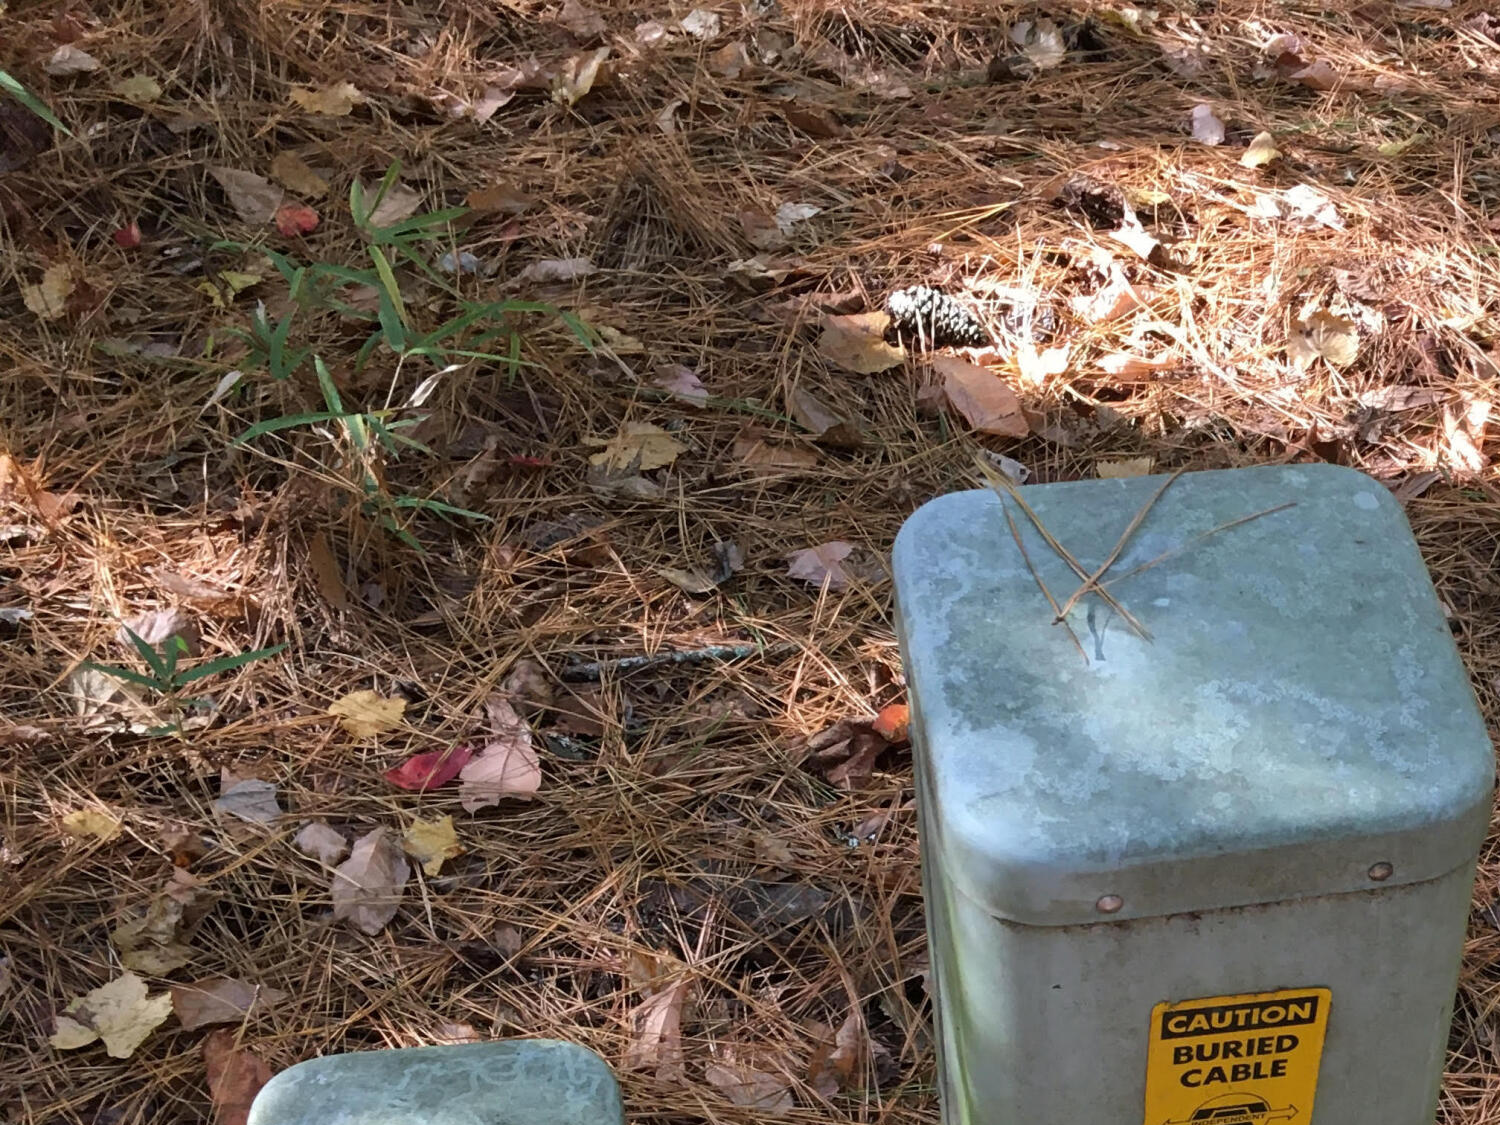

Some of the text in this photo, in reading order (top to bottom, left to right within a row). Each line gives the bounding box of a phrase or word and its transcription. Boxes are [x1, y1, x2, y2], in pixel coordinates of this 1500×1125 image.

[1167, 1002, 1312, 1034] CAUTION
[1173, 1034, 1299, 1065] BURIED
[1180, 1059, 1288, 1088] CABLE
